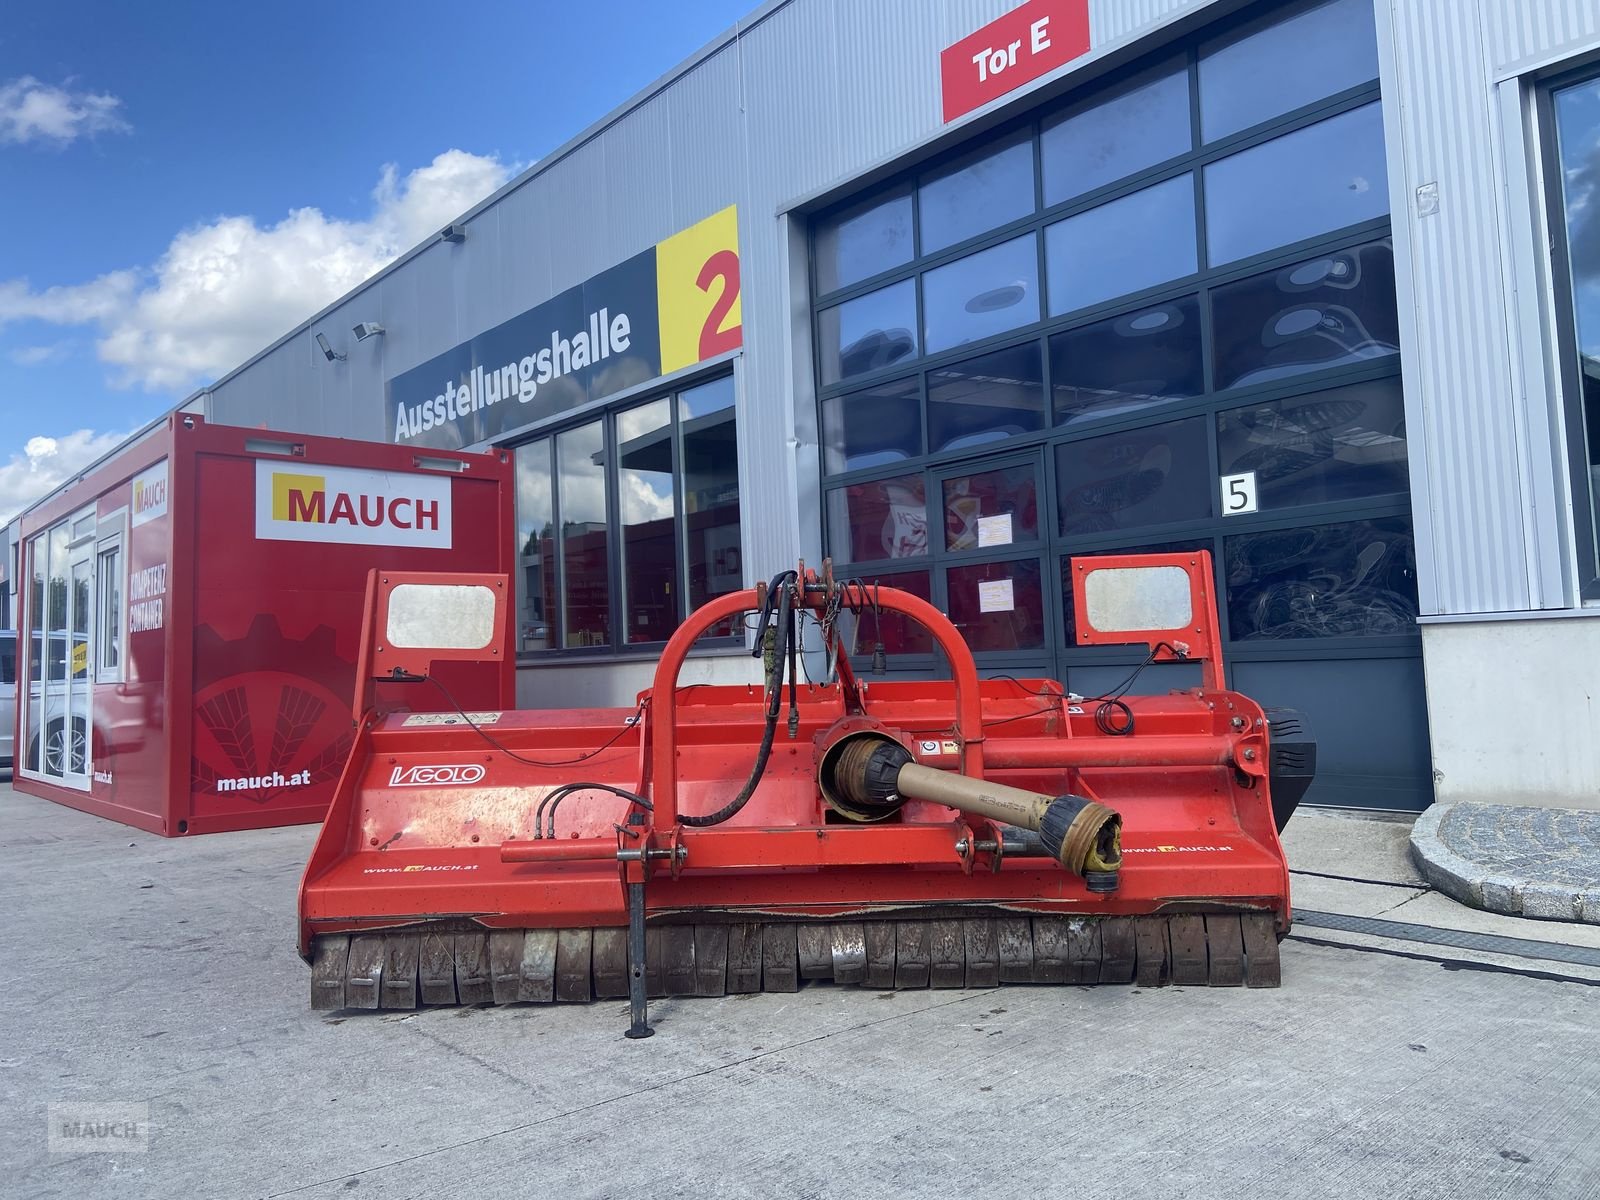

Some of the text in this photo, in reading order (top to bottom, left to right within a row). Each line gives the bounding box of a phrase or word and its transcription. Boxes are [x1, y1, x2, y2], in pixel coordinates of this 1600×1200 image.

[972, 16, 1051, 82] Tor E
[394, 249, 743, 443] Ausstellungshalle 2
[136, 479, 166, 513] MAUCH
[288, 488, 438, 531] MAUCH
[1229, 478, 1248, 510] 5
[217, 769, 311, 792] mauch.at
[391, 765, 483, 785] VIGOLO
